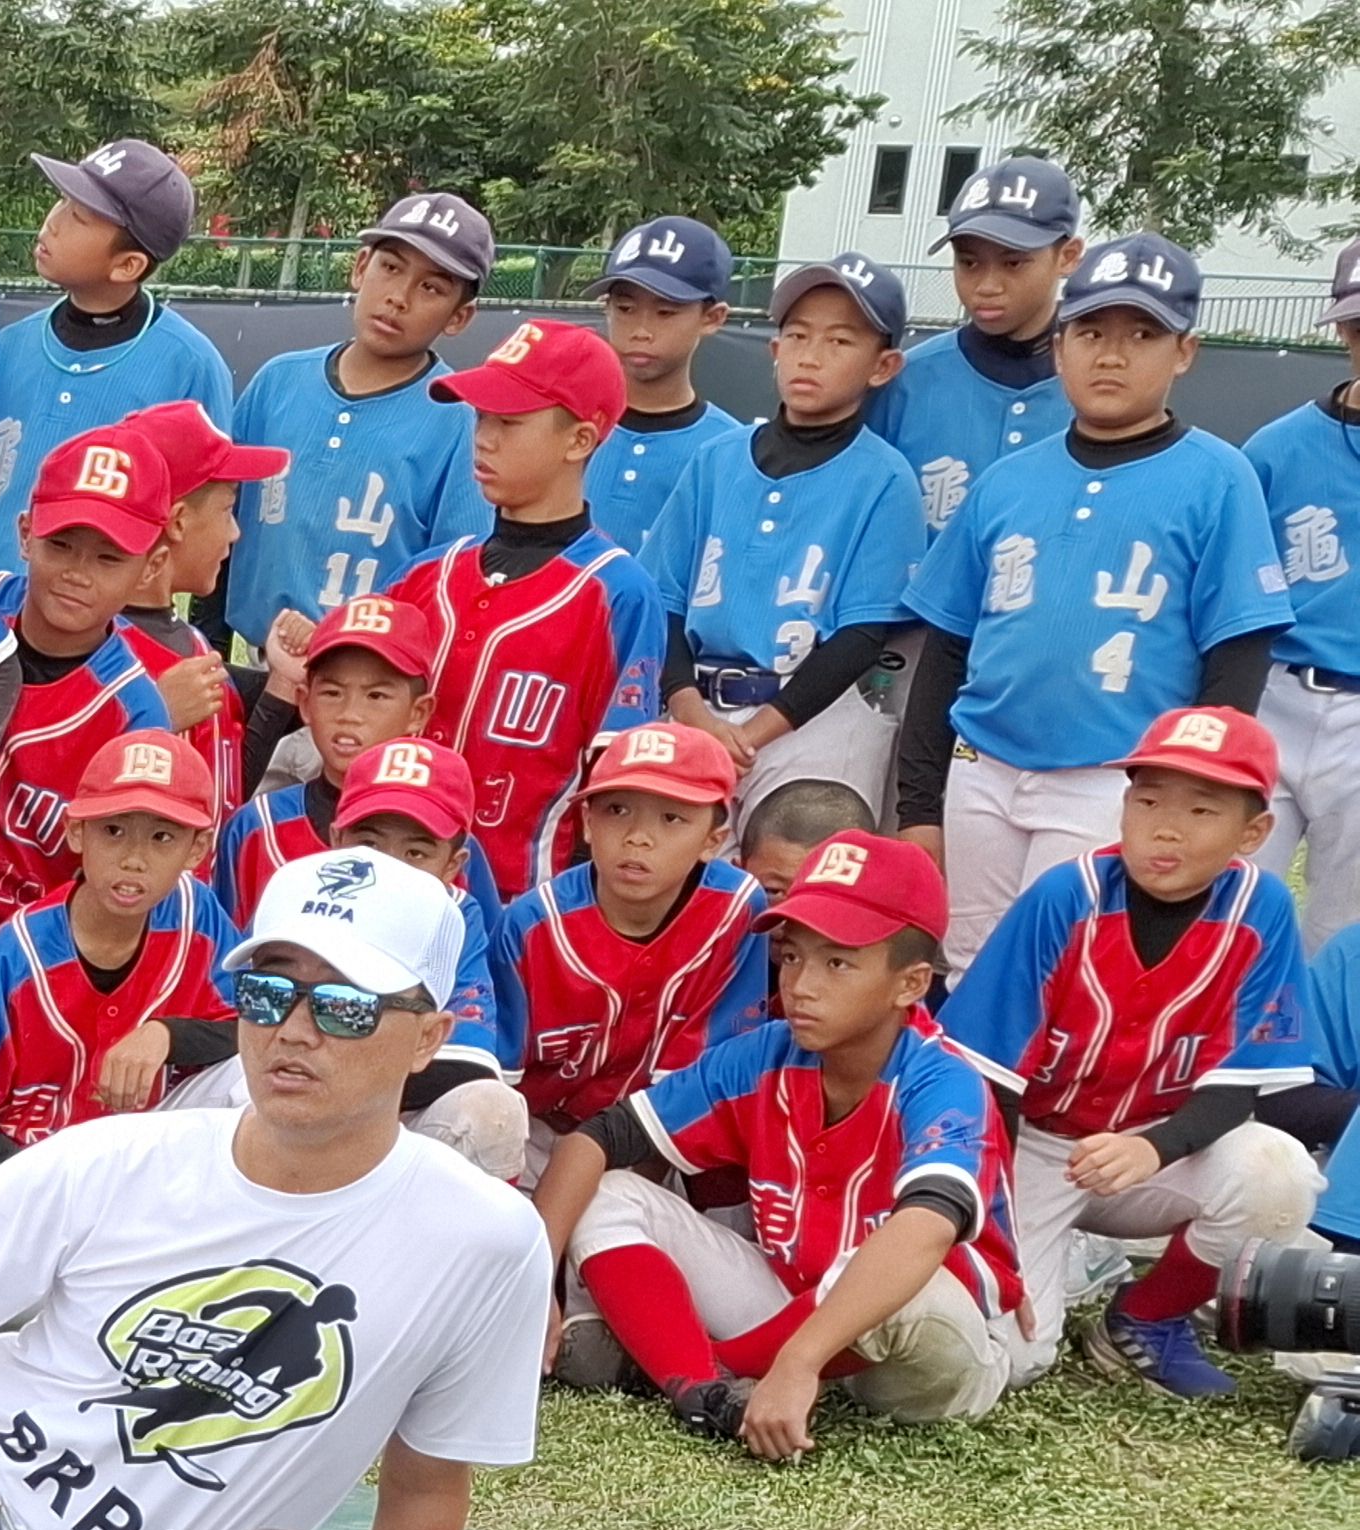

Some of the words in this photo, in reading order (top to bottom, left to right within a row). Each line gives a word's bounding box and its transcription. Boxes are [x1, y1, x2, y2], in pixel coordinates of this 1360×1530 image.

[1091, 251, 1174, 292] 龜山
[774, 619, 817, 674] 3
[1091, 631, 1136, 692] 4
[301, 900, 355, 924] BRPA
